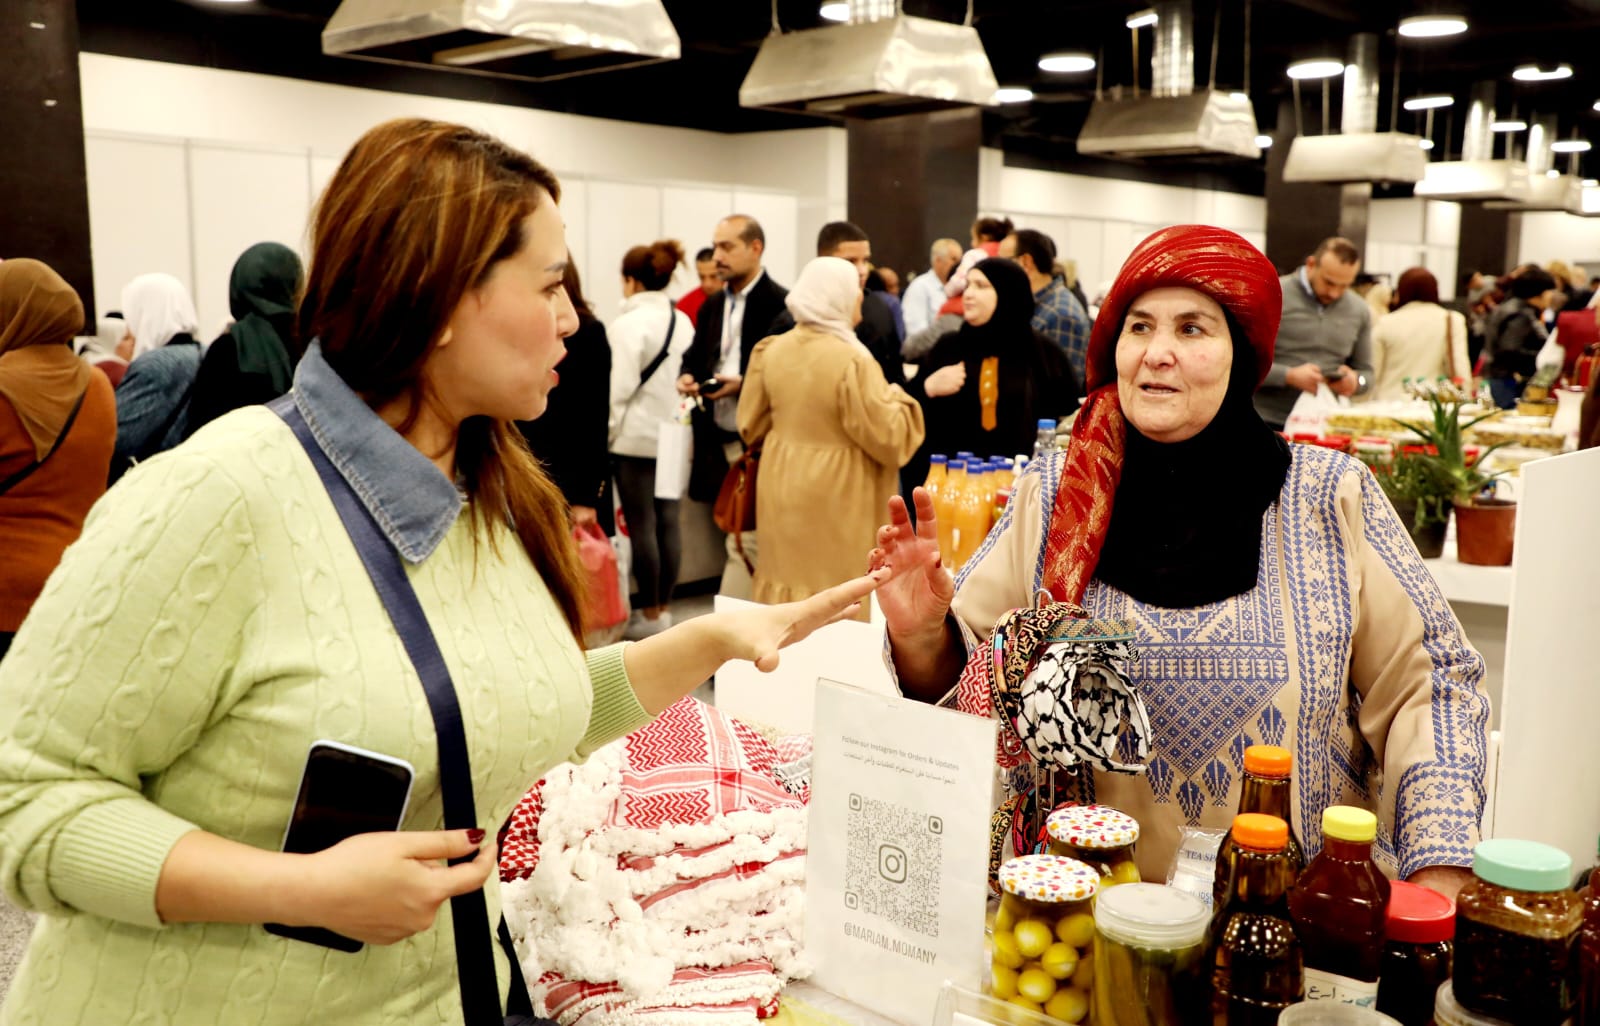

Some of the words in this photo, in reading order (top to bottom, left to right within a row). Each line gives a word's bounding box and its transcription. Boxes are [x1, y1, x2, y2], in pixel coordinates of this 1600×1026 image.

[841, 735, 859, 744] Follow
[870, 743, 898, 755] Instagram
[907, 752, 927, 763] Orders
[935, 759, 959, 770] Updates
[1186, 849, 1202, 860] TEA
[1203, 852, 1217, 862] SP
[843, 921, 937, 966] @MARIAM.MOMANY
